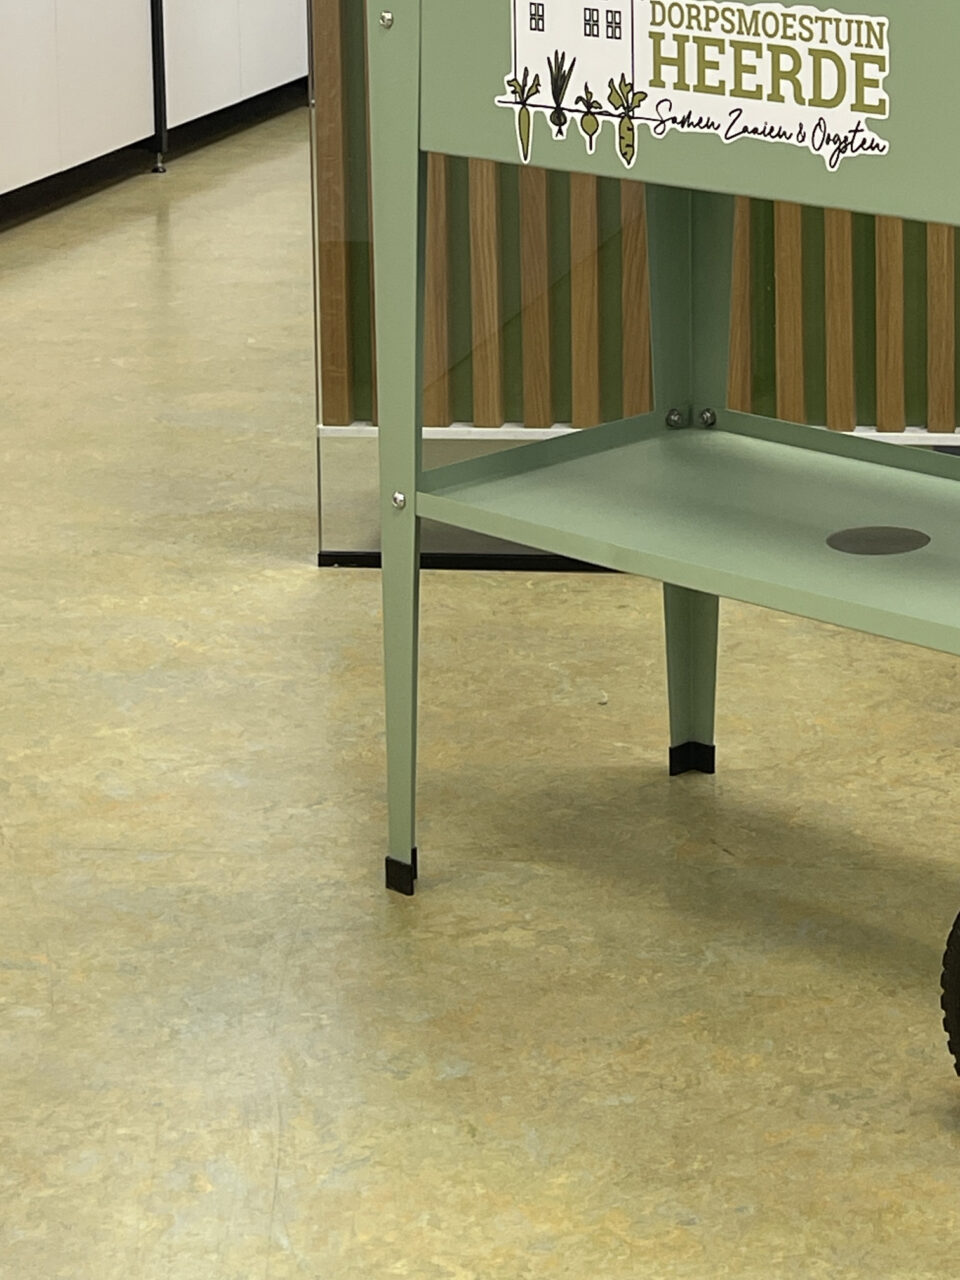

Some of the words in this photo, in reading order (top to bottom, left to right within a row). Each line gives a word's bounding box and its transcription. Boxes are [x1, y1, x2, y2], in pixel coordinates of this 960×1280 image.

[650, 0, 886, 49] DORPSMOESTUIN
[648, 31, 886, 115] HEERDE
[653, 98, 720, 136] Samen
[724, 108, 792, 140] Zaaien
[796, 122, 806, 142] &
[812, 117, 886, 168] Oogsten
